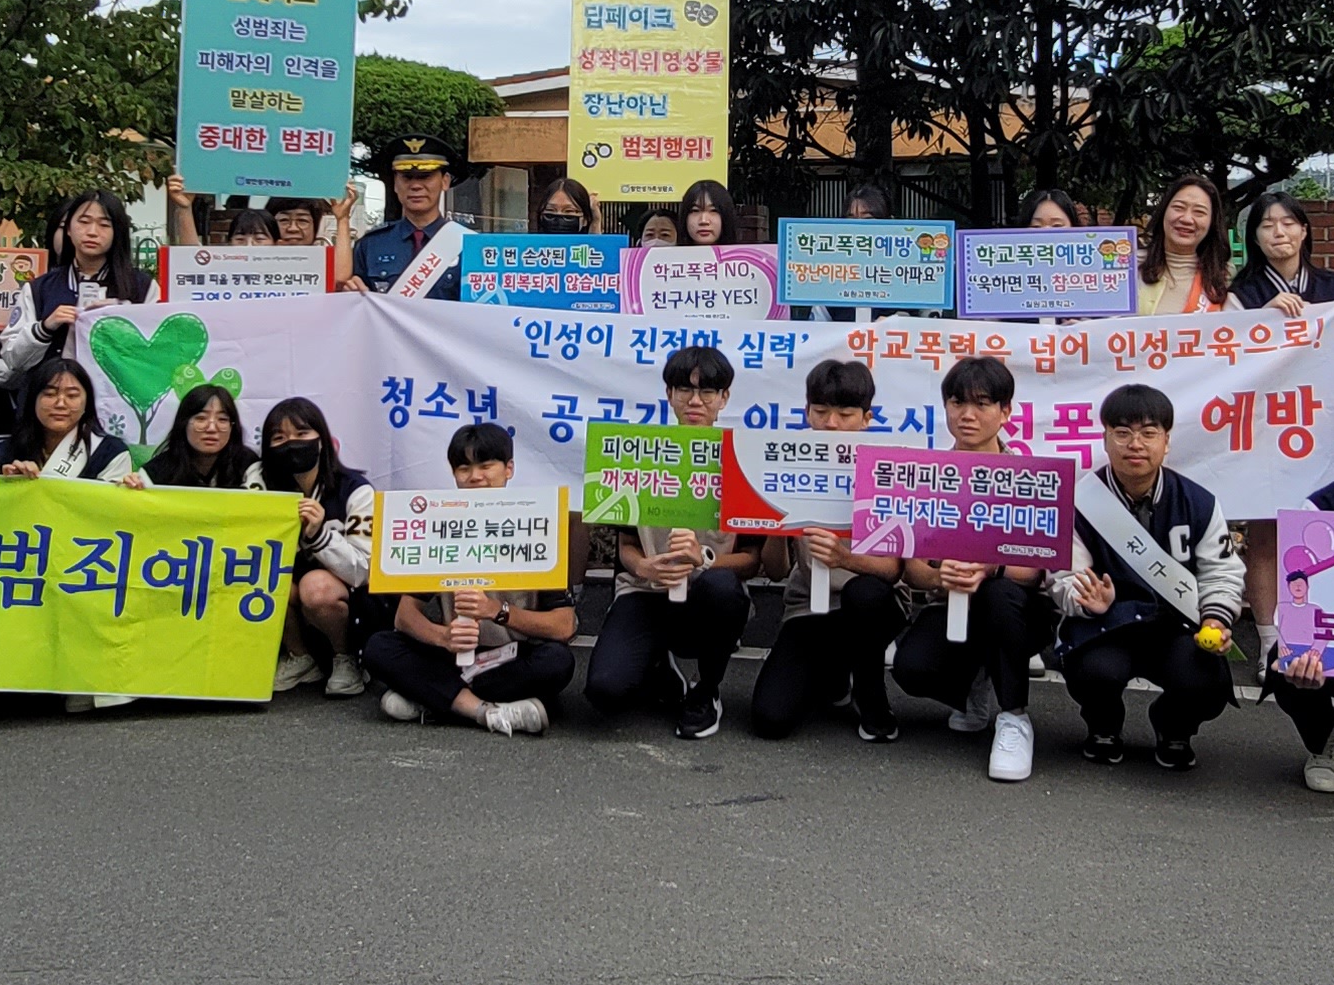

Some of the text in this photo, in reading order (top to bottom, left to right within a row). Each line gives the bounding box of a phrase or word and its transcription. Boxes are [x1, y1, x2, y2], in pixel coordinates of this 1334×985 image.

[234, 17, 306, 41] 성범죄는
[583, 4, 675, 30] 딥페이크
[198, 51, 338, 79] 피해자의 인격을
[578, 48, 724, 74] 성적허위영상물
[230, 89, 304, 112] 말살하는
[583, 93, 668, 117] 장난아닌
[198, 125, 335, 154] 중대한 범죄!
[622, 136, 713, 160] 범죄행위!
[482, 245, 604, 267] 한 번 손상된 폐는
[797, 232, 913, 258] 학교폭력예방
[976, 243, 1095, 267] 학교폭력예방
[653, 261, 756, 280] 학교폭력 NO,
[865, 265, 893, 284] 나는
[468, 273, 497, 293] 평생
[503, 273, 559, 293] 회복되지
[1051, 273, 1100, 293] 참으면
[651, 288, 759, 310] 친구사랑 YES!
[1029, 331, 1089, 374] 넘어
[1107, 316, 1323, 372] 인성교육으로!
[1201, 385, 1324, 460] 예방
[602, 436, 682, 464] 피어나는
[764, 442, 830, 462] 흡연으로
[601, 469, 680, 496] 꺼져가는
[763, 472, 829, 493] 금연으로
[873, 461, 1060, 499] 몰래피운 흡연습관
[872, 496, 1057, 536] 무너지는 우리미래
[392, 516, 550, 541] 금연 내일은 늦습니다
[390, 542, 548, 565] 지금 바로 시작하세요
